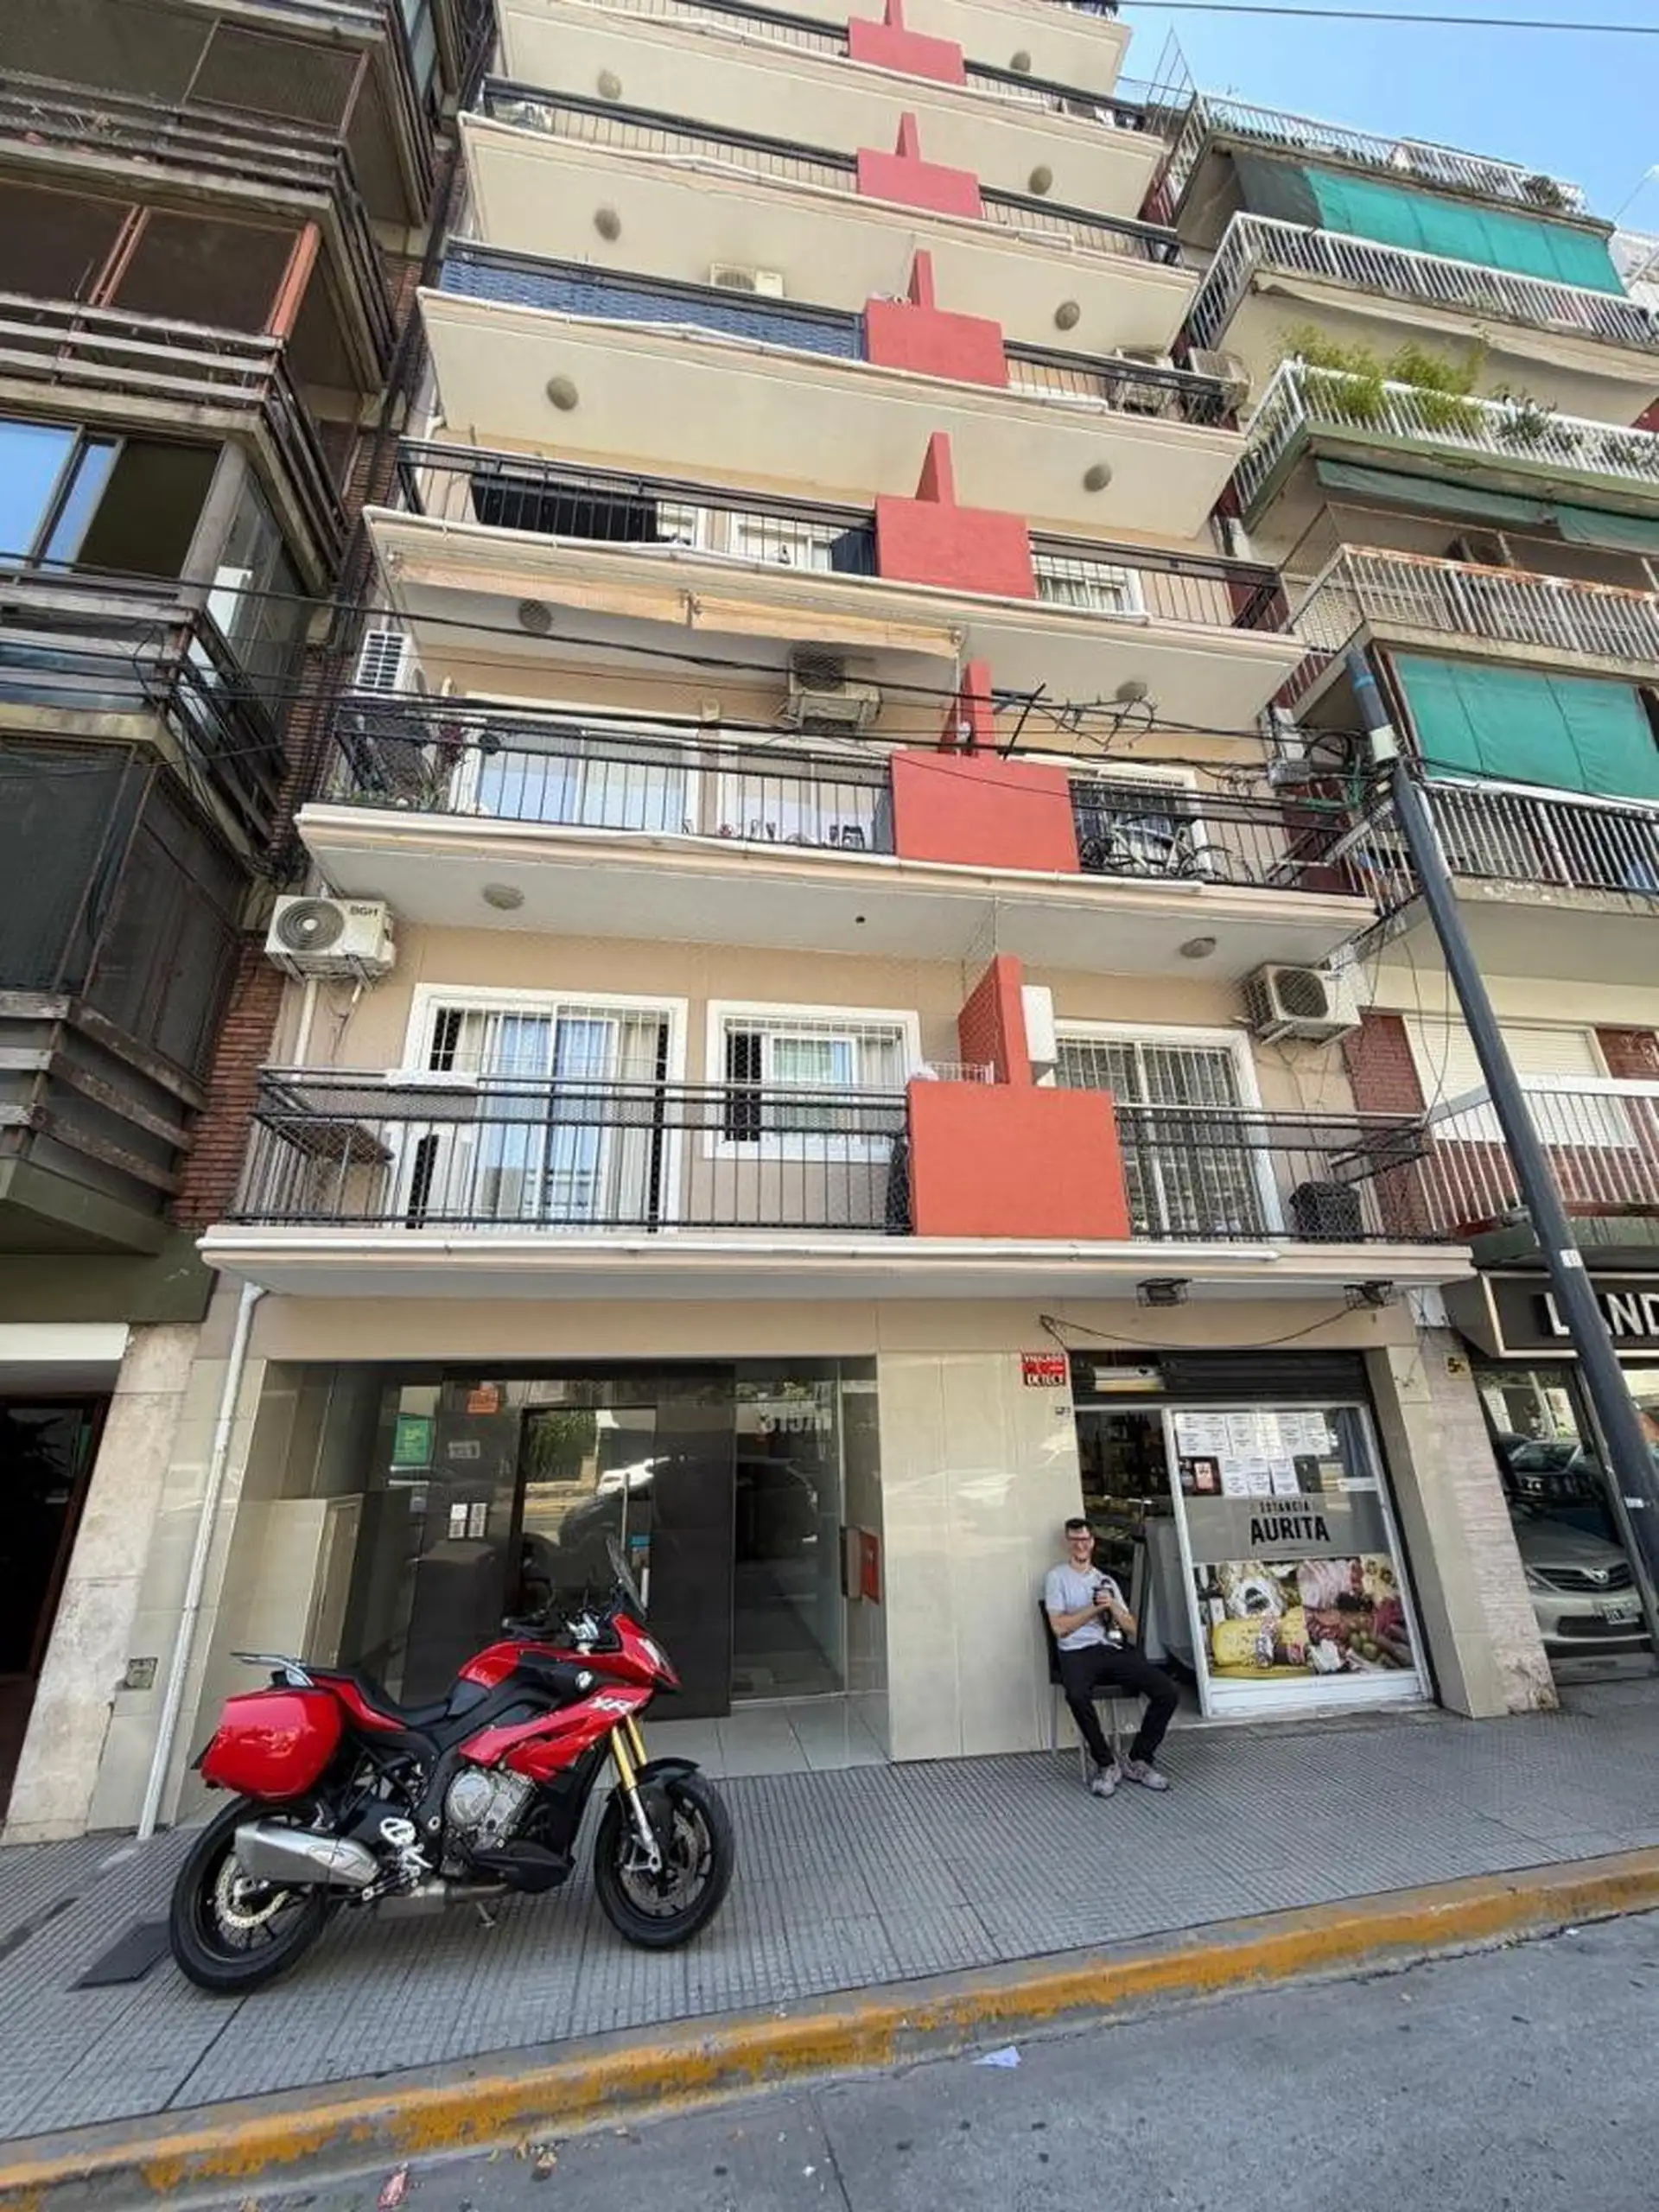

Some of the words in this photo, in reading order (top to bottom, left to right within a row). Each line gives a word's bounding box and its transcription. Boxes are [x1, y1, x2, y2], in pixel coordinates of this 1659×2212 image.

[350, 906, 378, 917] BGH
[1543, 1292, 1659, 1336] LND
[1259, 1499, 1311, 1514] ESTANCIA
[1250, 1516, 1332, 1546] AURITA
